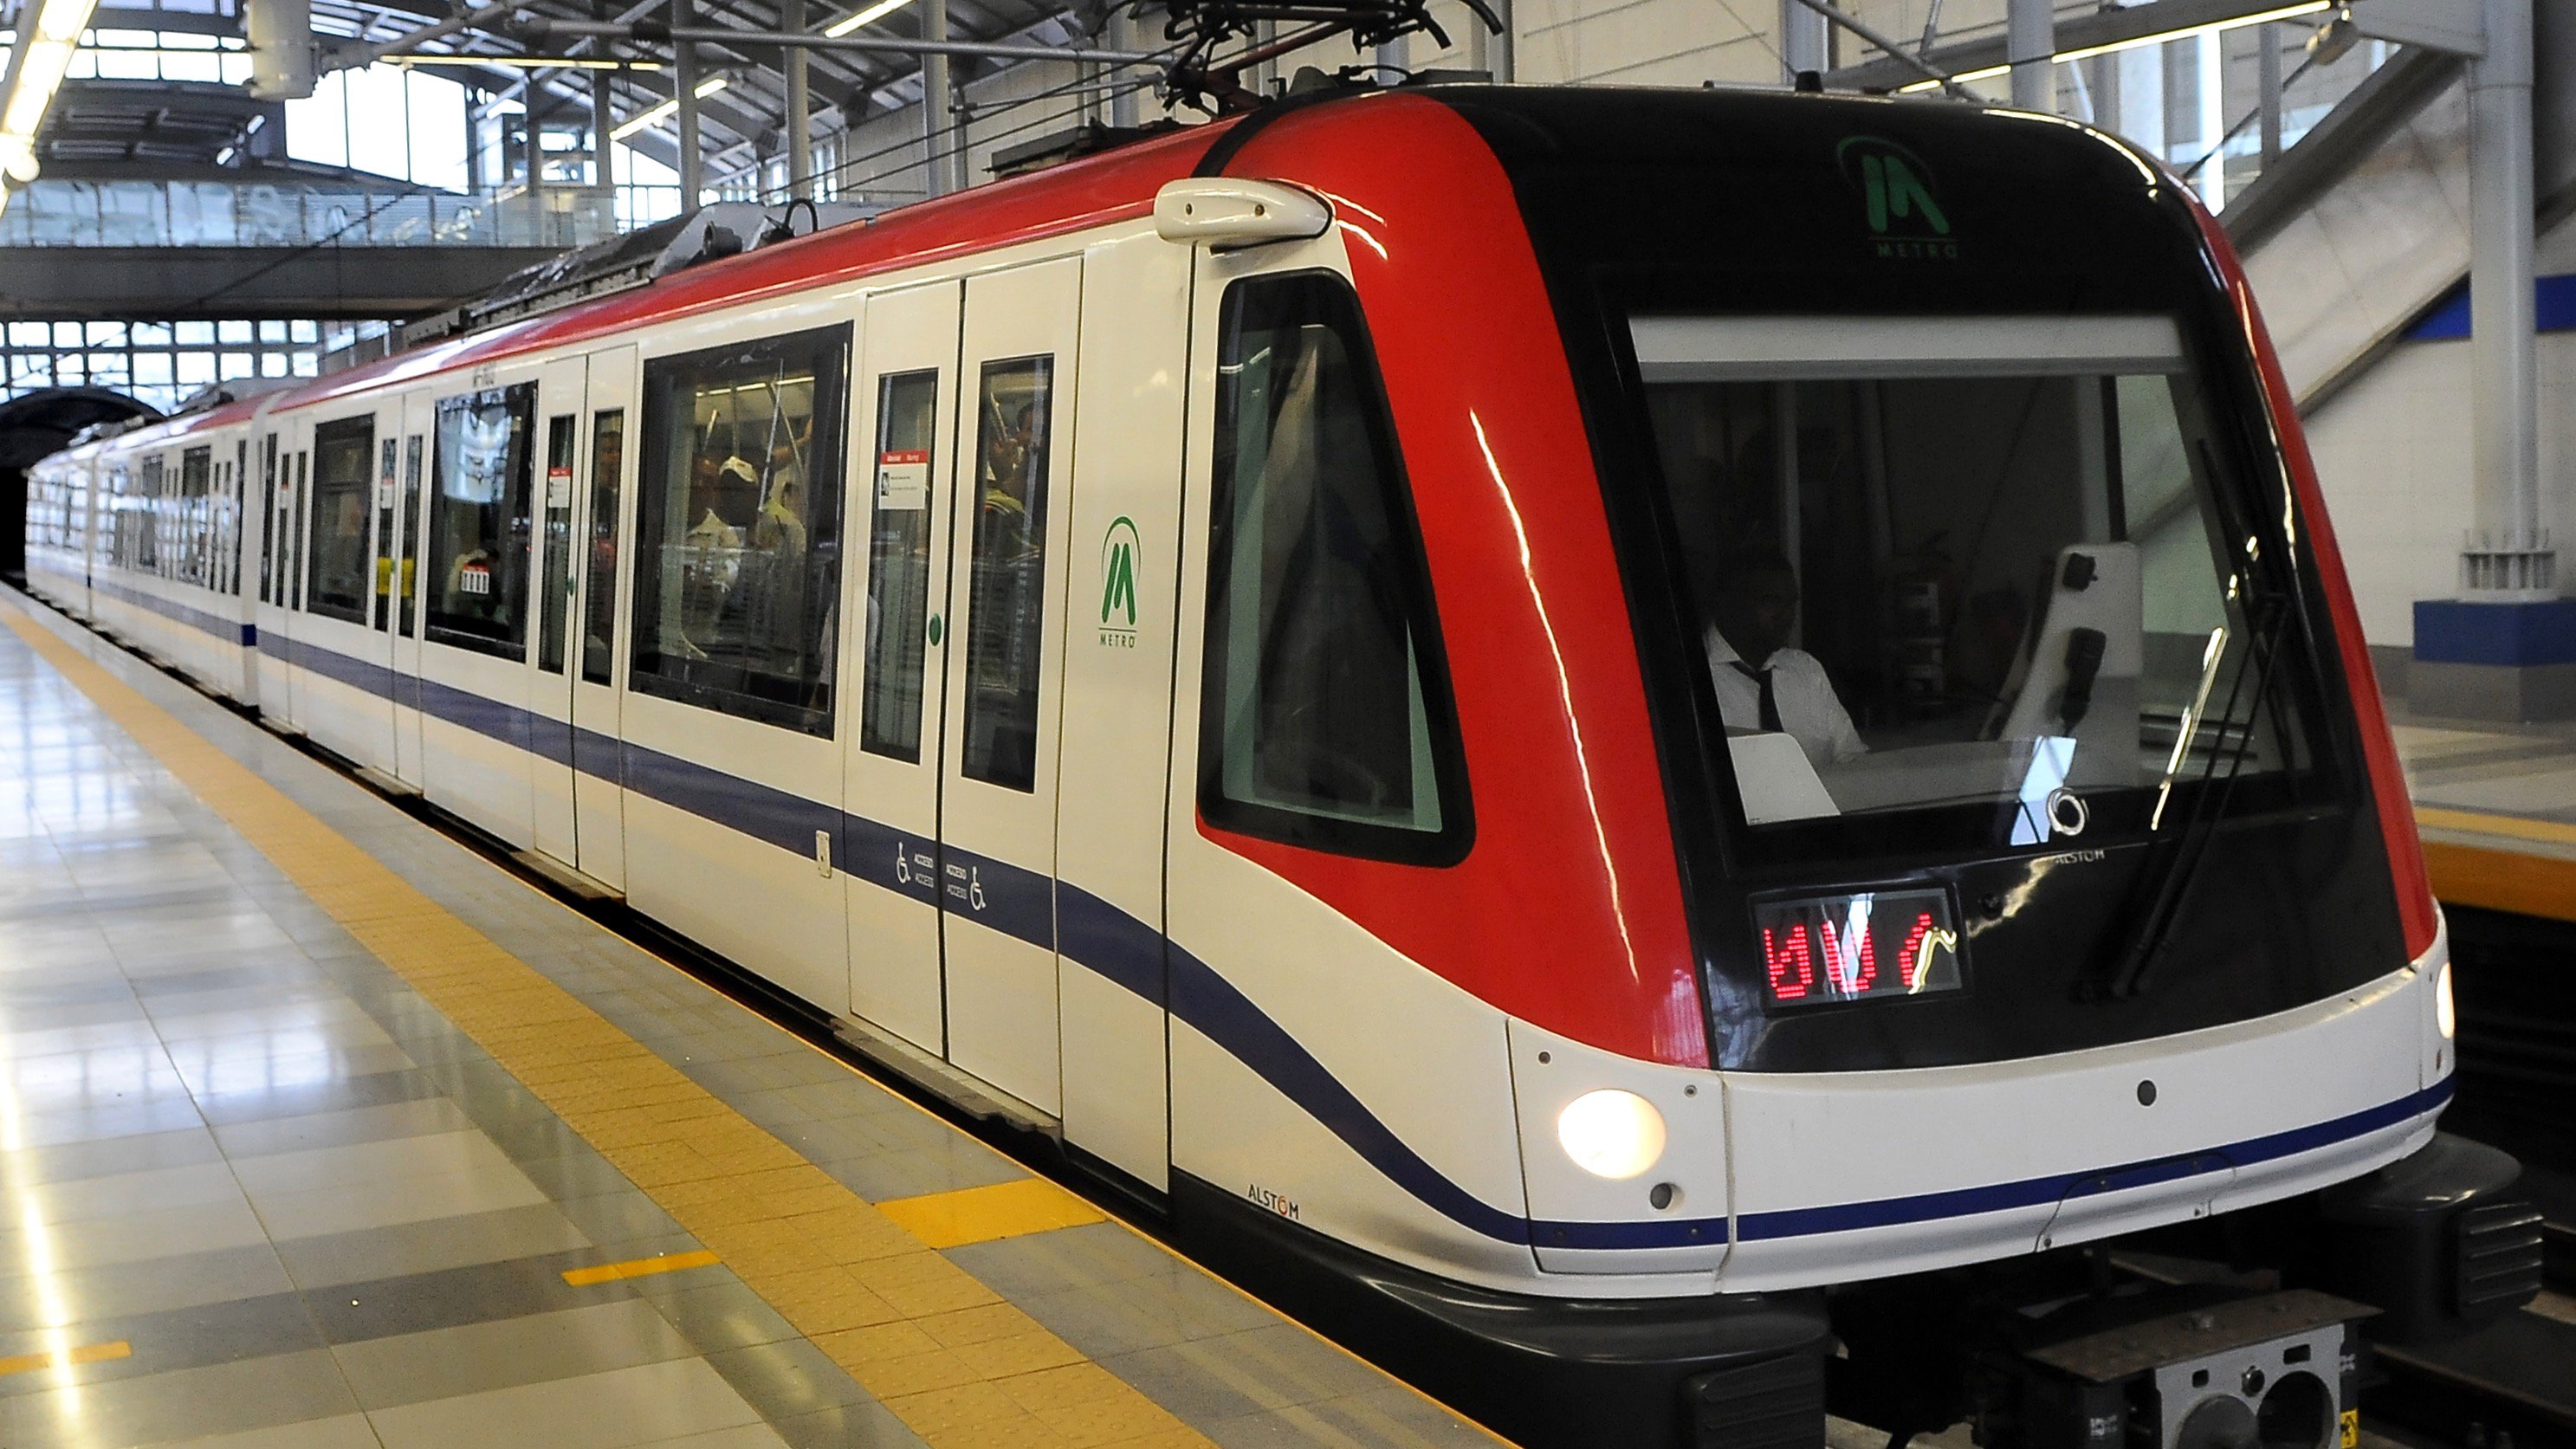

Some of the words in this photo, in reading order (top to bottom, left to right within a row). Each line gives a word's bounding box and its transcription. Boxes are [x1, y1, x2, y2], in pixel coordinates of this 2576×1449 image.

[1877, 243, 1958, 259] METRO
[1099, 634, 1135, 649] METRO
[915, 873, 935, 889] ACCESS
[947, 883, 968, 900] ACCESS
[1248, 1183, 1300, 1220] ALSTOM
